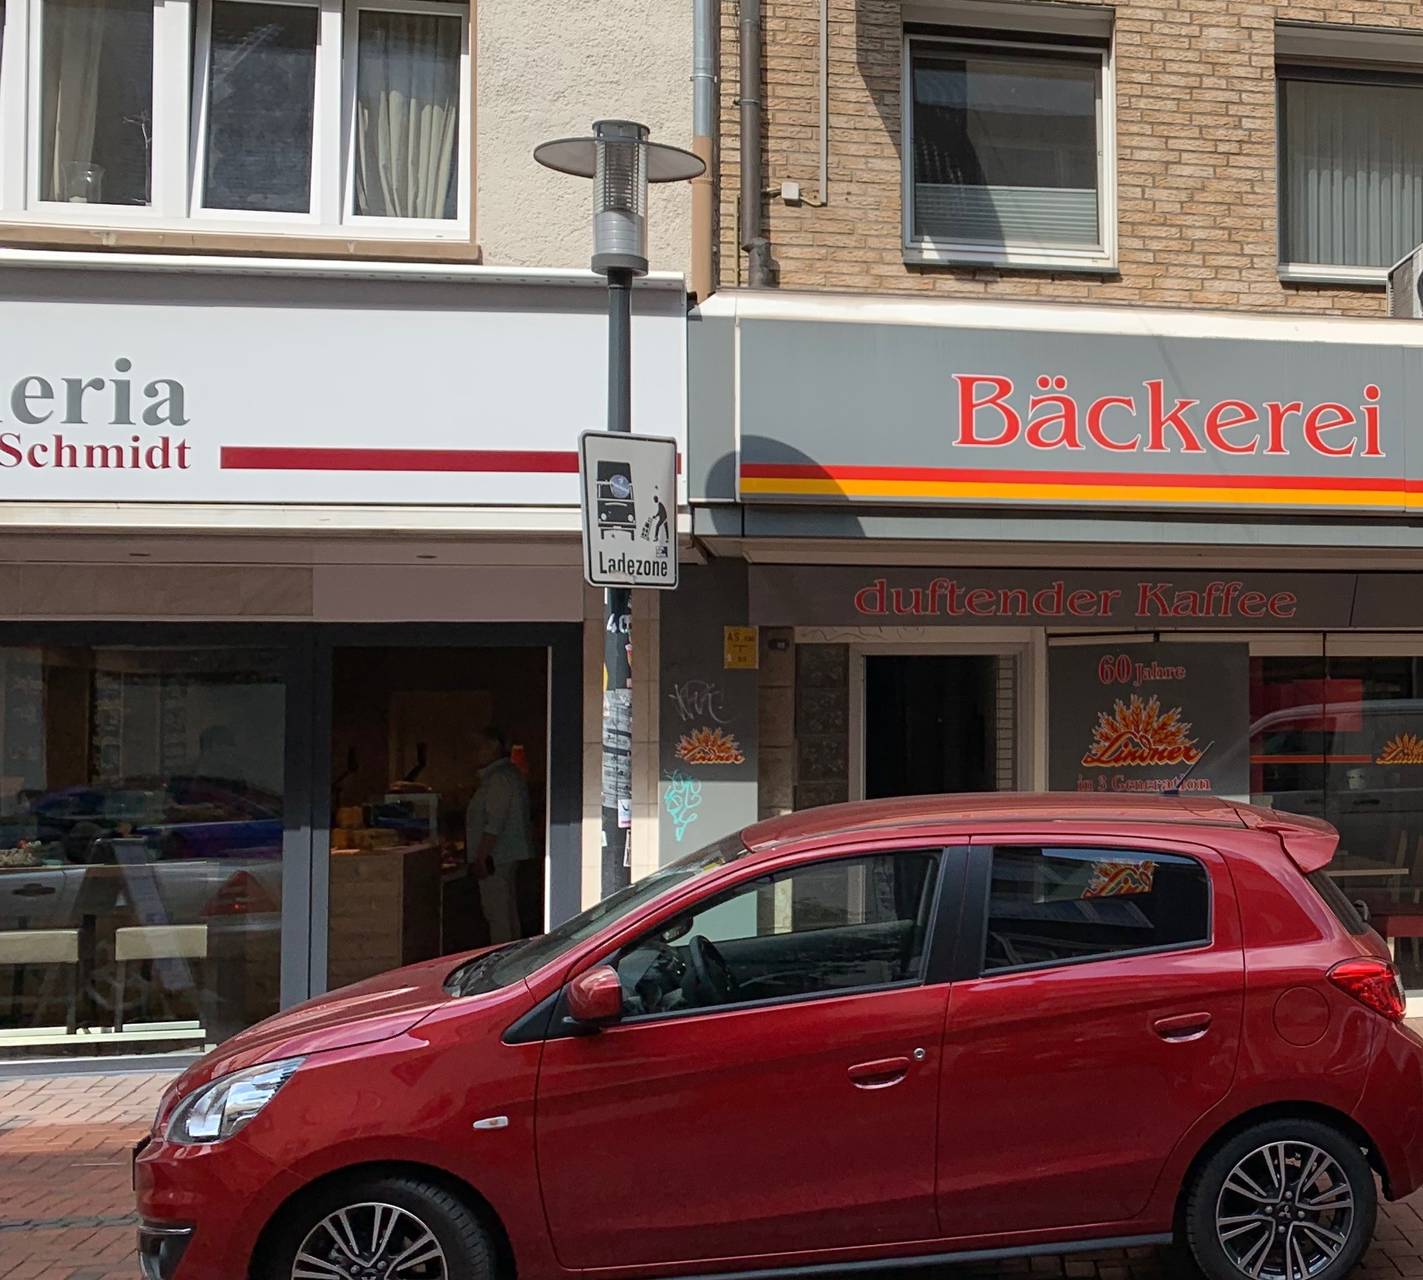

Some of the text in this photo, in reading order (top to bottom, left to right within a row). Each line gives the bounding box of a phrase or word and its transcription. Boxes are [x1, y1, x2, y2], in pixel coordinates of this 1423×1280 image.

[0, 357, 191, 426] eria
[951, 373, 1386, 457] Bäckerei
[0, 432, 192, 470] Schmidt
[599, 551, 669, 577] Ladezone
[853, 578, 1297, 619] duftender Kaffee
[1098, 654, 1186, 686] 60 Jahre
[1081, 730, 1203, 767] Lindner
